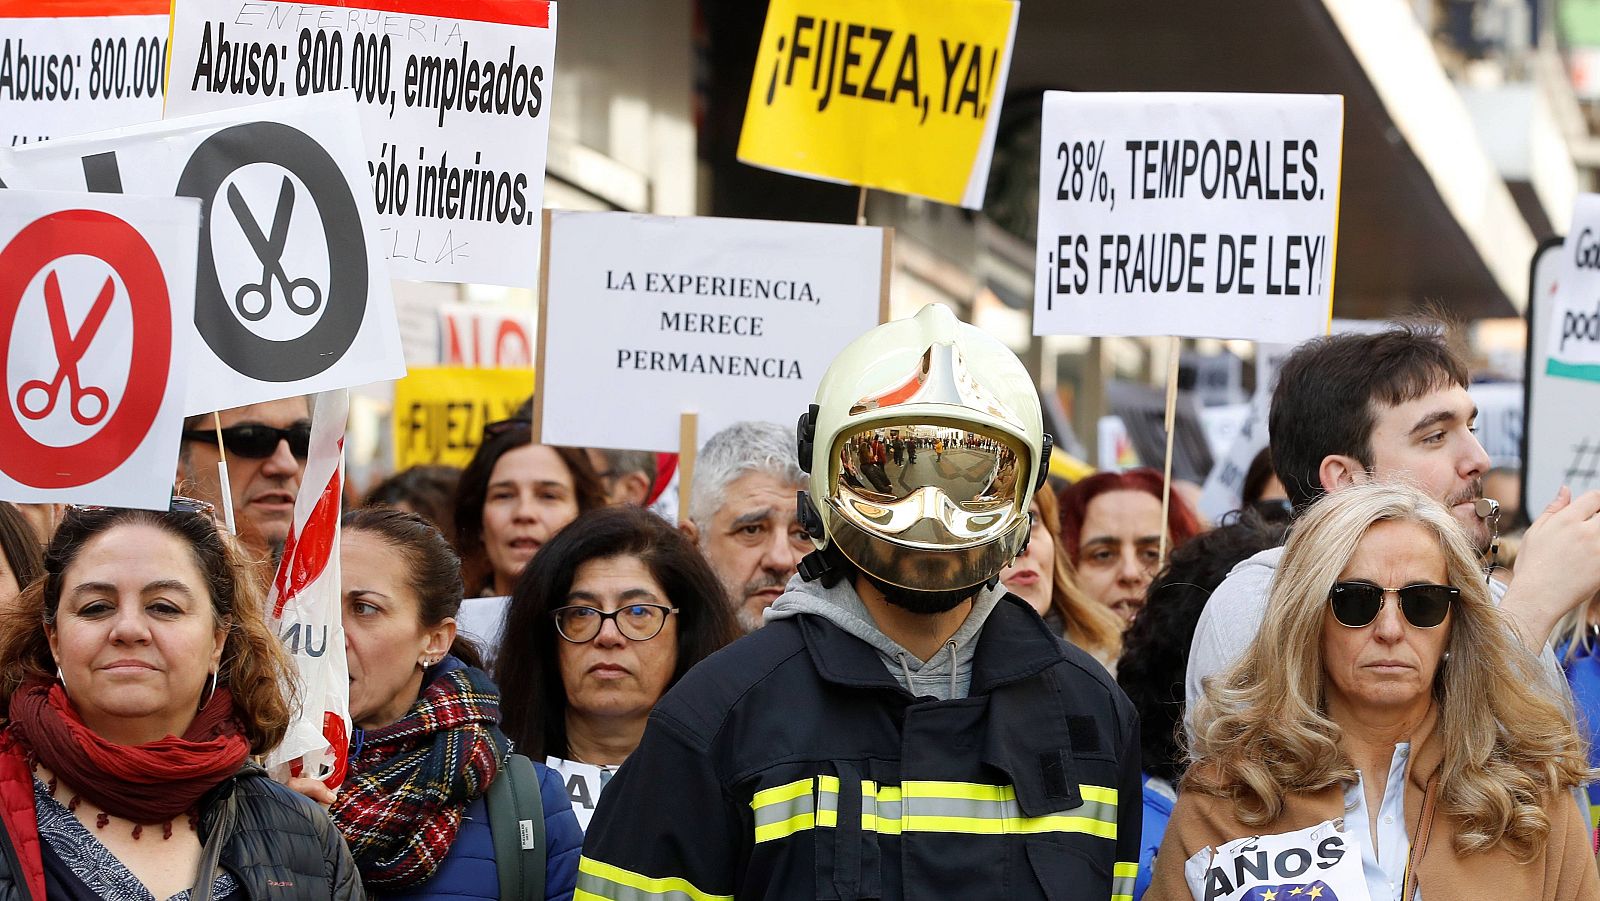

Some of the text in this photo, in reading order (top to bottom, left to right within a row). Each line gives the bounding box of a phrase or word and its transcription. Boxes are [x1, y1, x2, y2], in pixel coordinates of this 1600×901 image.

[0, 38, 81, 101] Abuso:
[191, 20, 287, 97] Abuso:
[404, 41, 544, 128] empleados
[767, 16, 998, 124] ¡FIJEZA, YA!
[415, 146, 533, 226] interinos.
[1057, 139, 1324, 211] 28%, TEMPORALES.
[606, 270, 822, 306] LA EXPERIENCIA,
[1047, 233, 1326, 311] ¡ES FRAUDE DE LEY!
[660, 312, 763, 337] MERECE
[616, 350, 803, 380] PERMANENCIA
[1203, 836, 1346, 901] AÑOS
